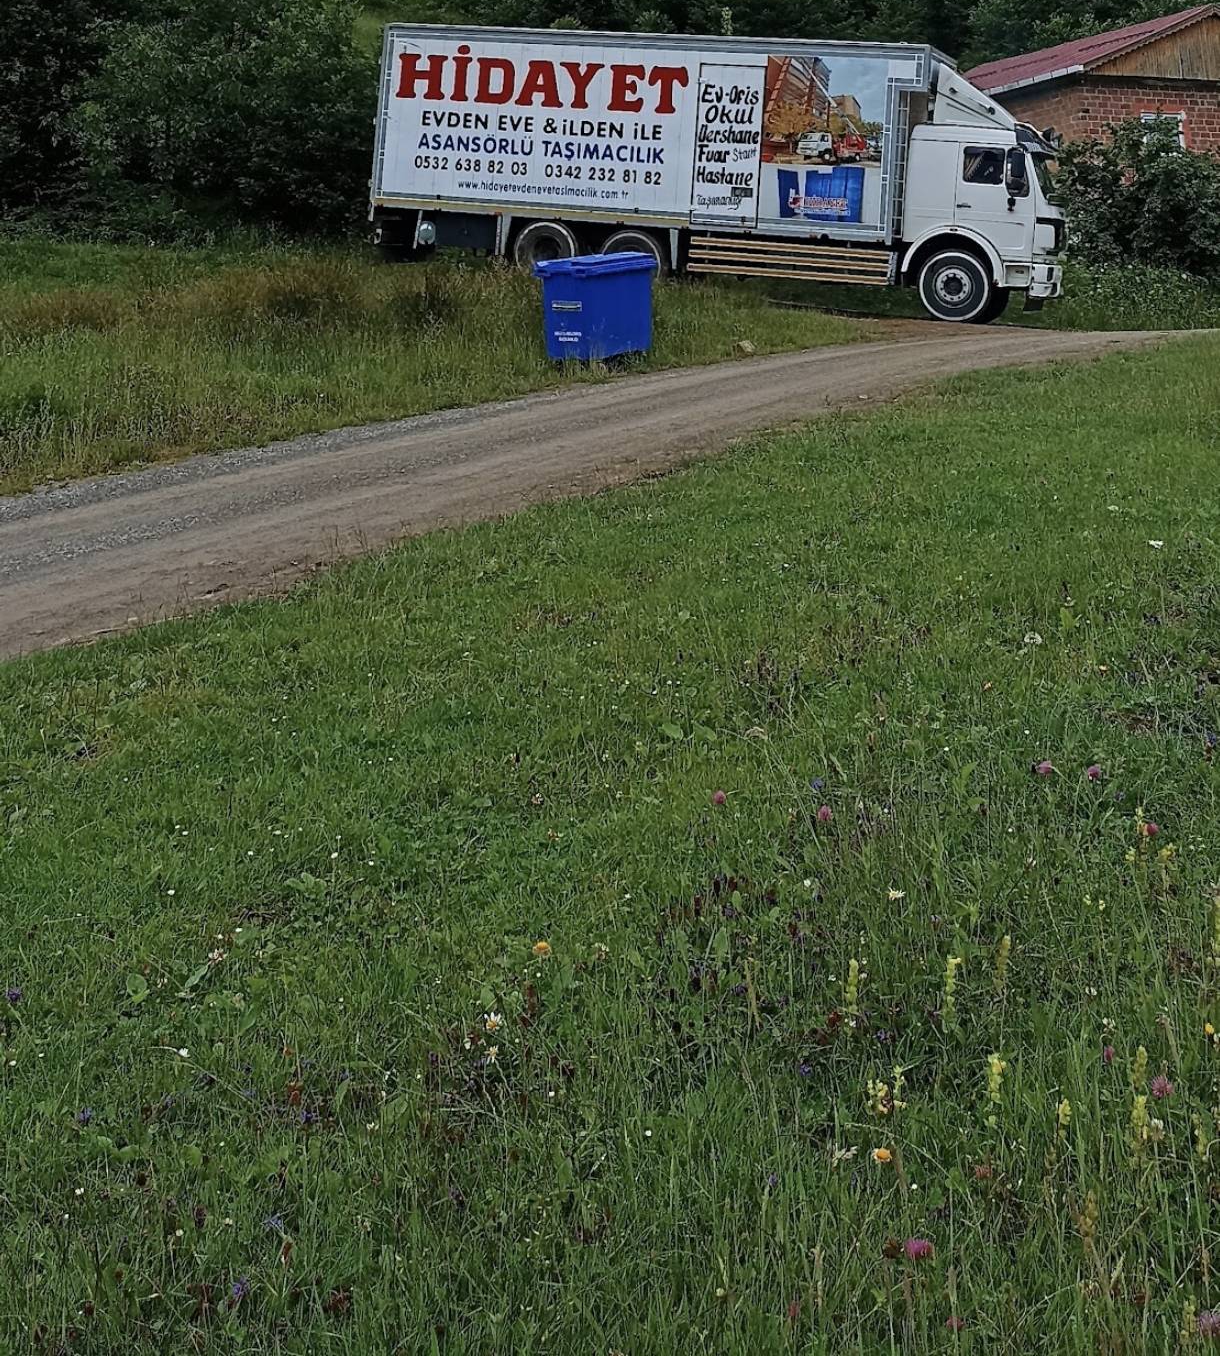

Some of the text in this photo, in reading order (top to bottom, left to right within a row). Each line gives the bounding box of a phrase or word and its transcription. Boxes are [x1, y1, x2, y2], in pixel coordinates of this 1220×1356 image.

[396, 44, 690, 114] HİDAYET
[701, 83, 760, 105] Ev-Ofis
[422, 110, 489, 130] EVDEN
[497, 115, 534, 133] EVE
[543, 117, 557, 133] &
[704, 105, 754, 124] Okul
[698, 124, 760, 144] Dershane
[418, 132, 665, 164] ASANSÖRLÜ TAŞIMACILIK
[698, 144, 731, 163] Fuar
[414, 155, 662, 185] 0532 638 82 03 0342 232 81 82
[696, 166, 754, 186] Hastane
